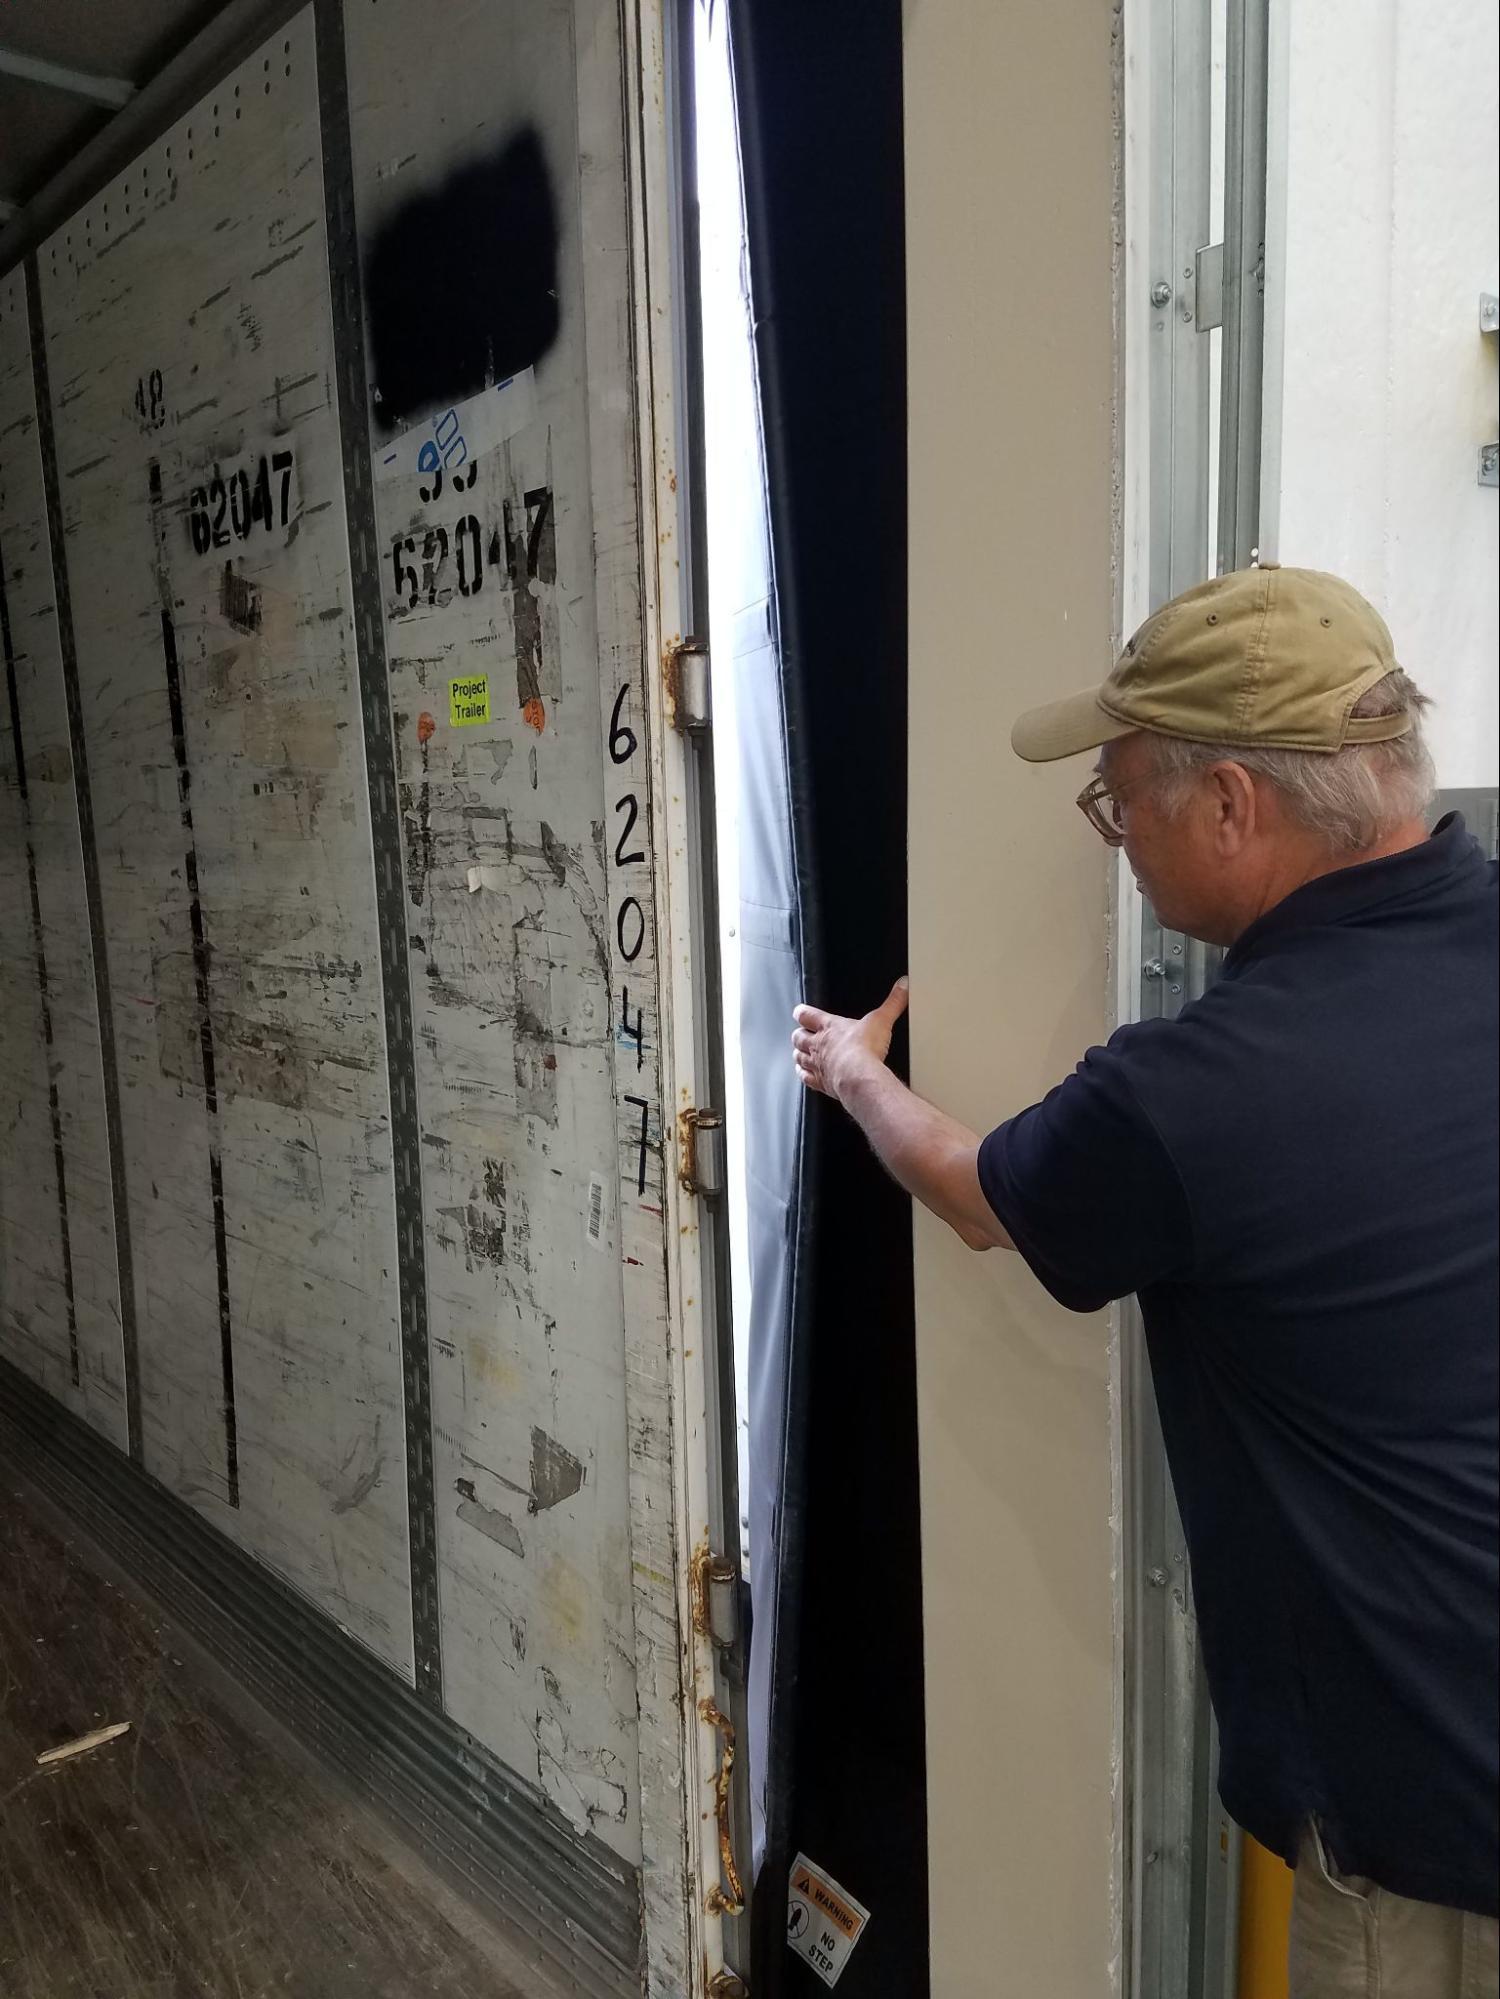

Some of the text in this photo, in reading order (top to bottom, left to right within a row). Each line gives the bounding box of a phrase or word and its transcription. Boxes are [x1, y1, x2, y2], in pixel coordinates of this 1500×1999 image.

[190, 451, 293, 556] 62047
[452, 679, 486, 699] Project
[455, 703, 486, 719] Trailer
[814, 1888, 854, 1931] WARNING
[820, 1931, 836, 1952] NO
[808, 1944, 834, 1972] STEP
